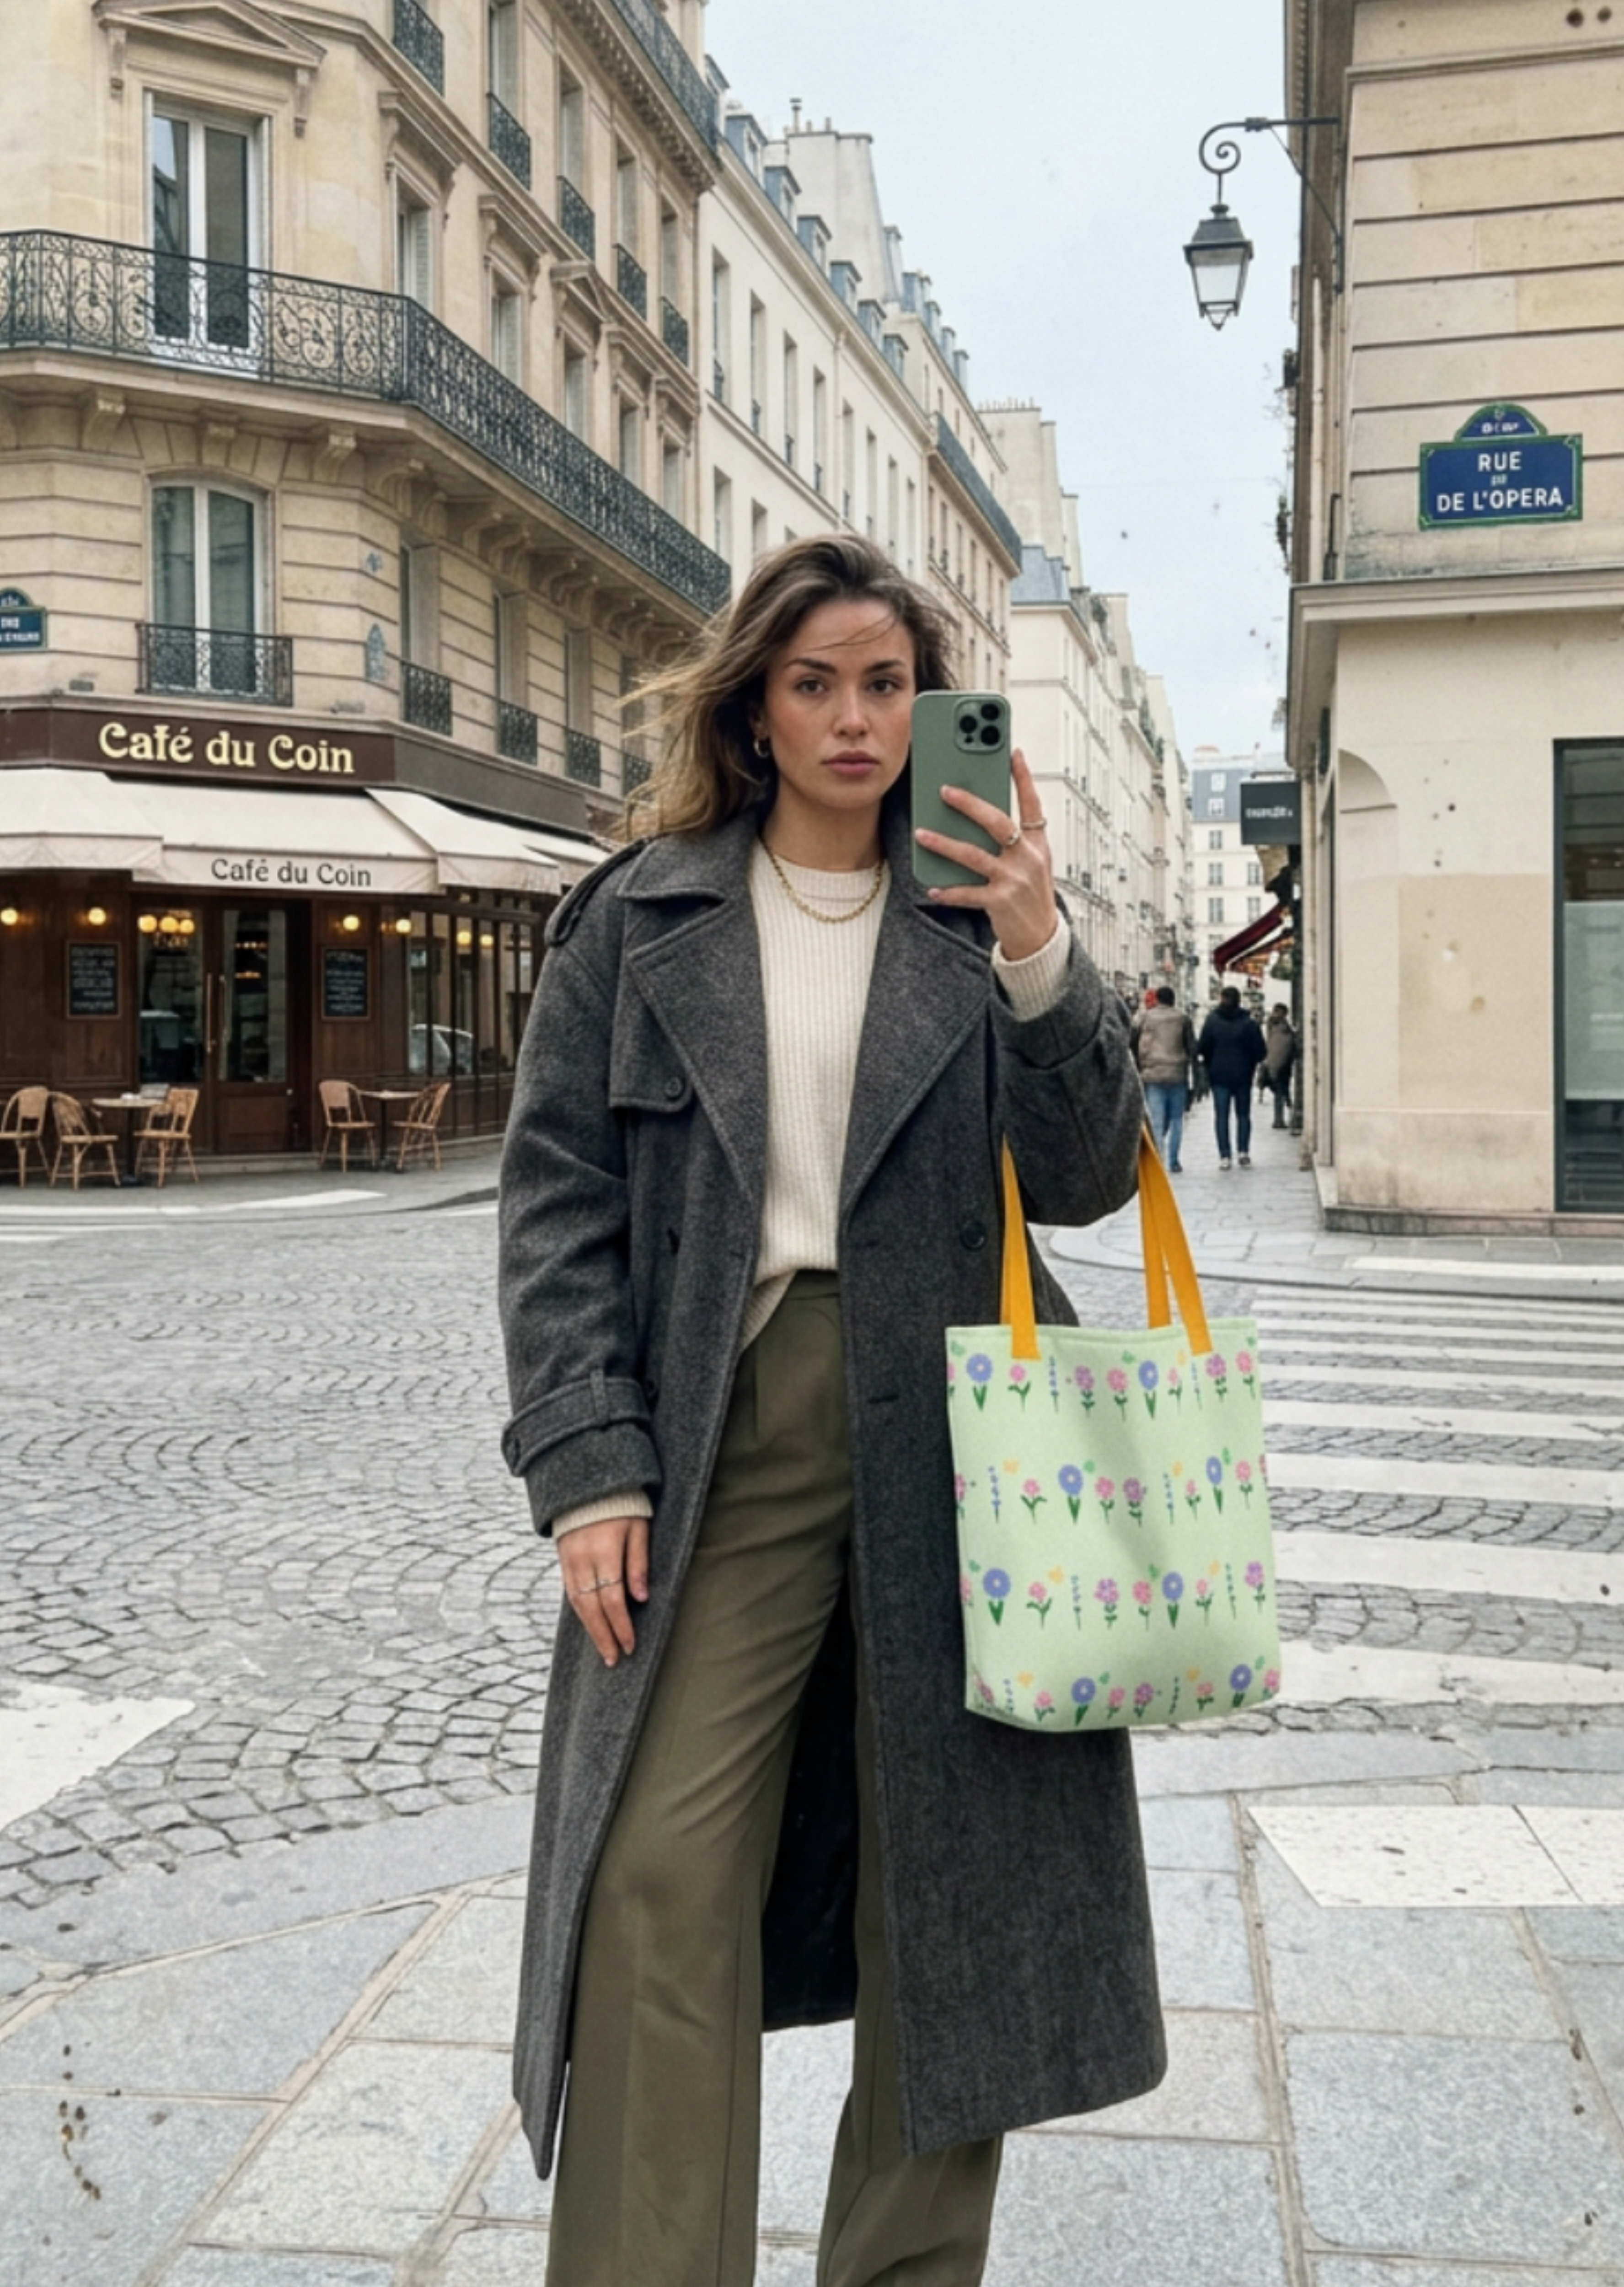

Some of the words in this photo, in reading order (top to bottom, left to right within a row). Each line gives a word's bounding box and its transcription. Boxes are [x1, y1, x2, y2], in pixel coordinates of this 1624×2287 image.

[1478, 451, 1522, 472] RUE
[1437, 493, 1464, 512] DE
[1473, 487, 1563, 510] L'OPERA
[99, 722, 193, 762] Café
[206, 731, 256, 766] du
[268, 734, 355, 773] Coin
[211, 859, 269, 882] Café
[277, 861, 308, 884] du
[316, 863, 371, 886] Coin
